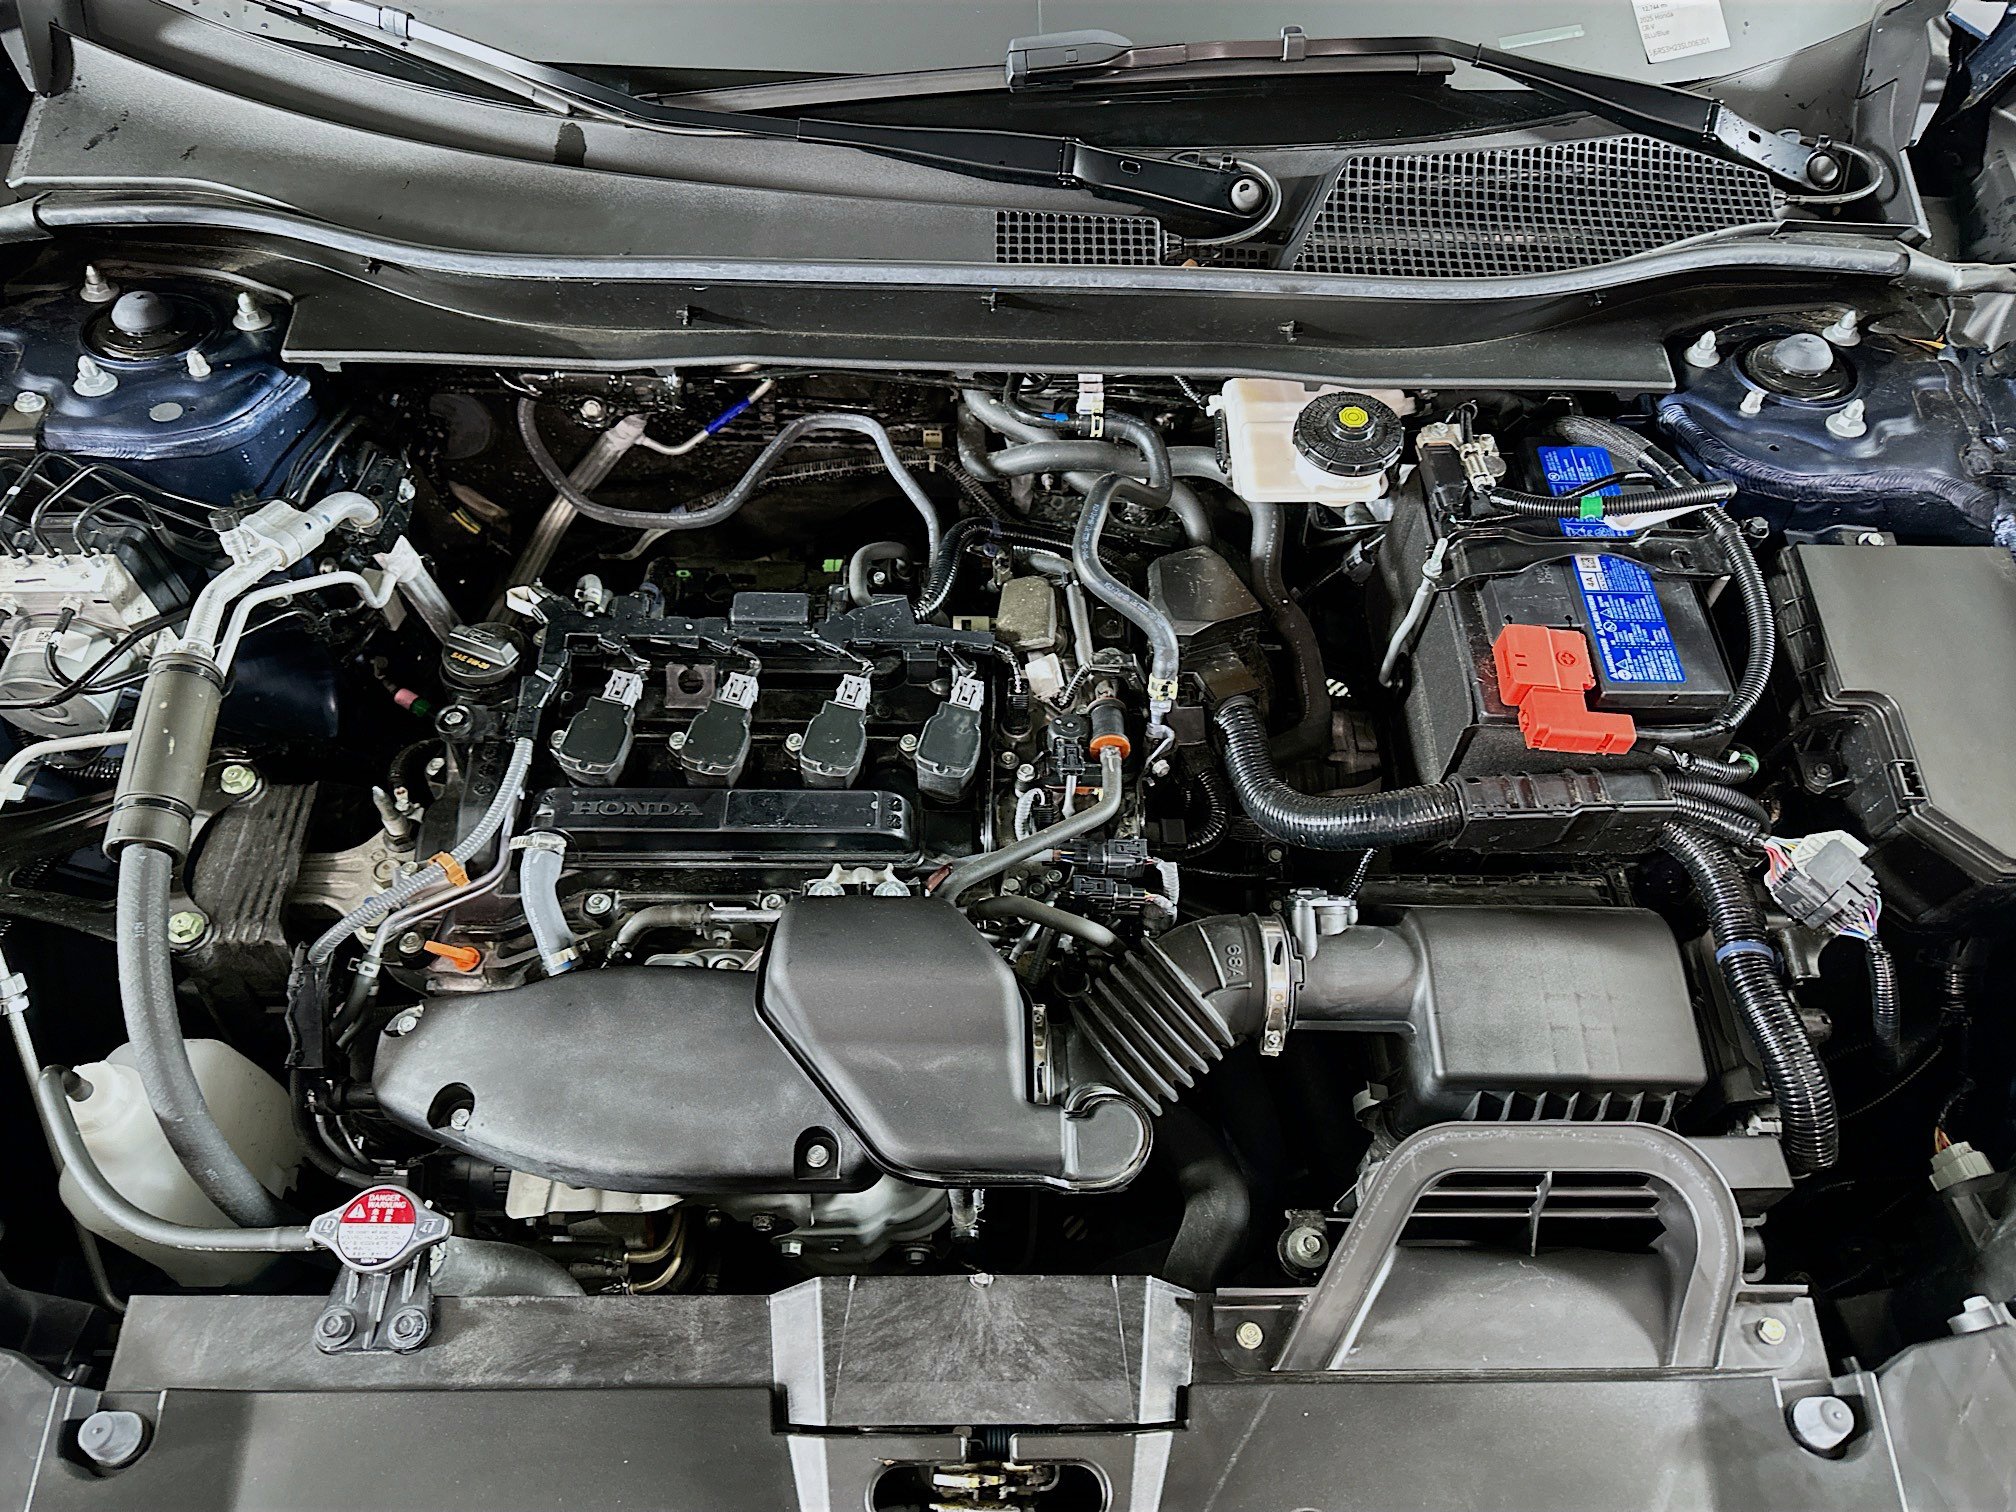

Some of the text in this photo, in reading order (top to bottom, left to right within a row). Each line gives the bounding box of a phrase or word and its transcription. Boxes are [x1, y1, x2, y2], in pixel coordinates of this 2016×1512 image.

[1655, 12, 1674, 20] Honda
[1585, 576, 1595, 588] 4A
[450, 652, 468, 661] SAE
[570, 800, 703, 816] HONDA
[1226, 943, 1245, 980] 68A
[368, 1194, 401, 1202] DANGER
